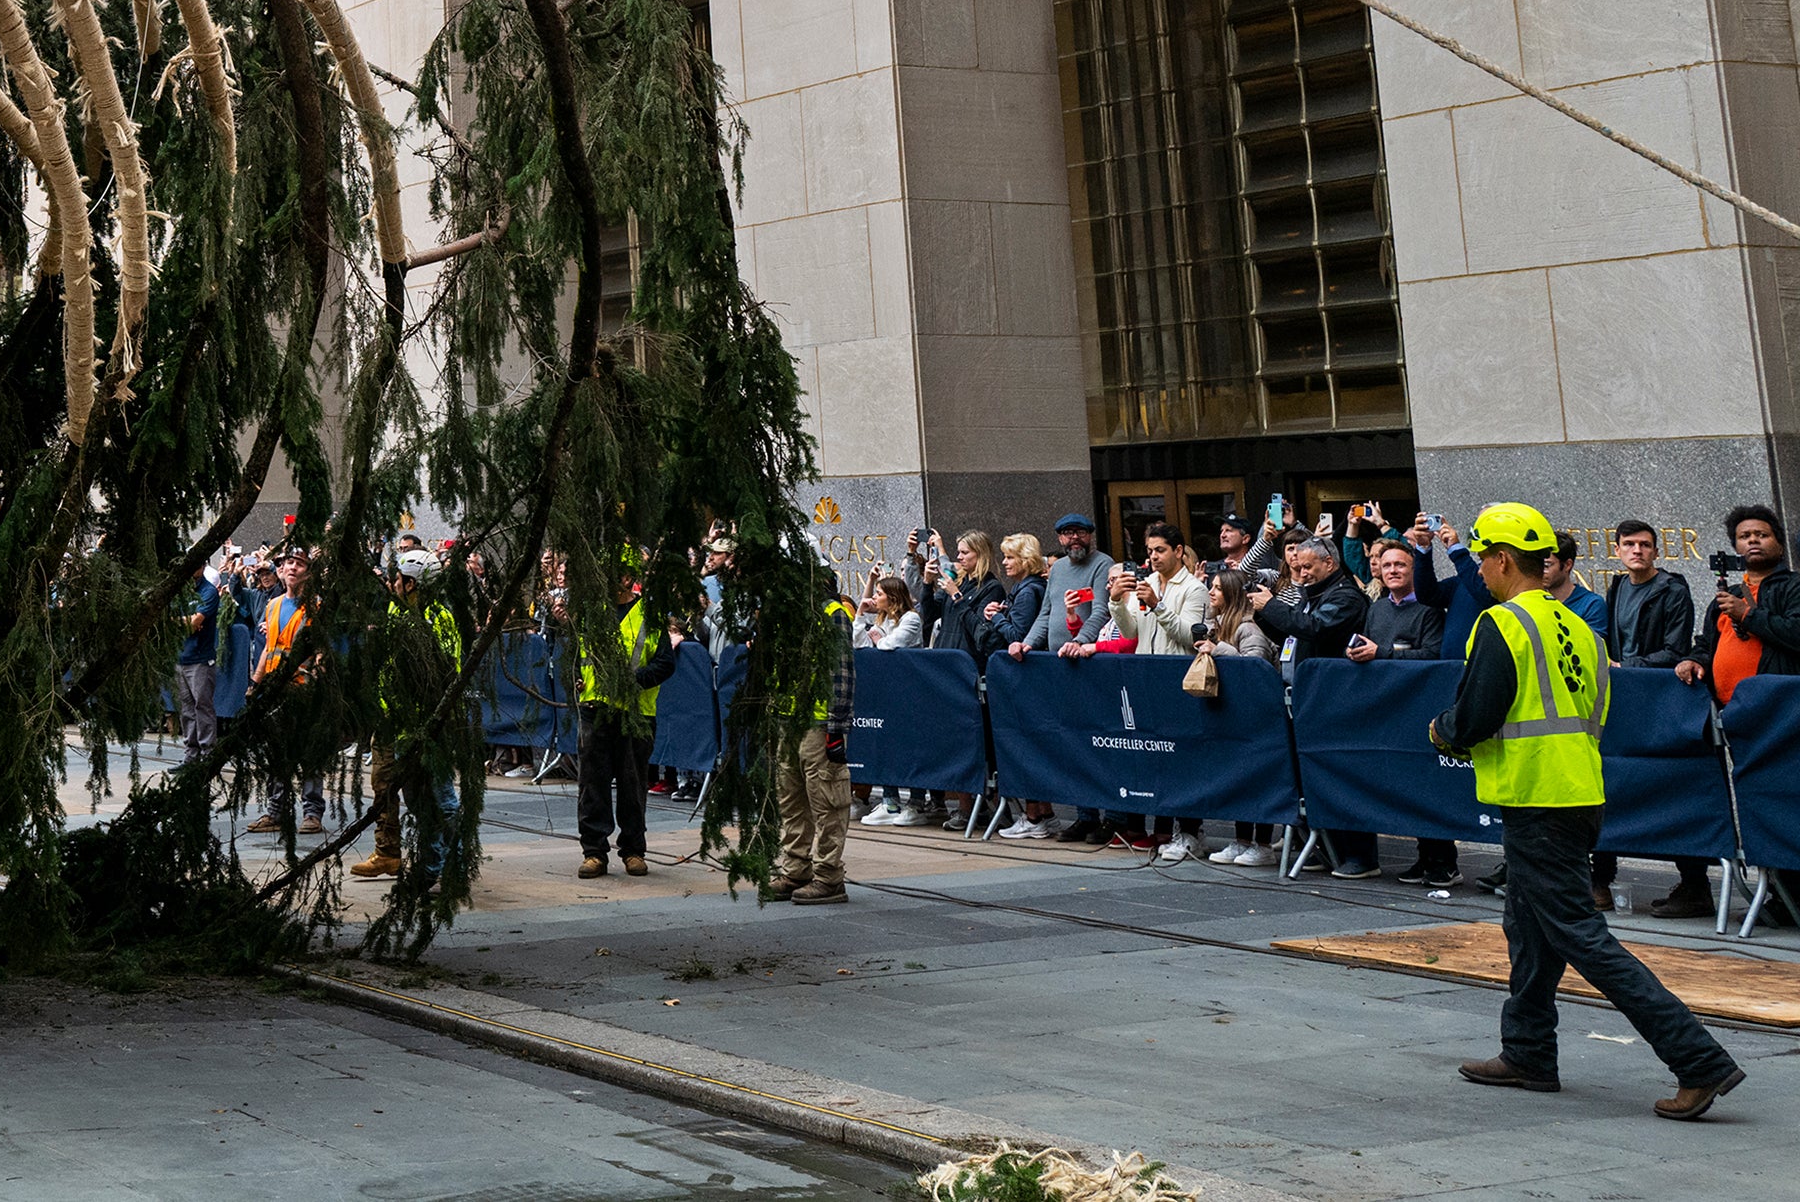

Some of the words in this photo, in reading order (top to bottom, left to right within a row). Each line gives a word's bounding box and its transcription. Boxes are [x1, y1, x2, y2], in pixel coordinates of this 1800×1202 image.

[819, 535, 888, 564] CAST
[1091, 736, 1144, 751] ROCKEFELLER
[1144, 740, 1175, 753] CENTER
